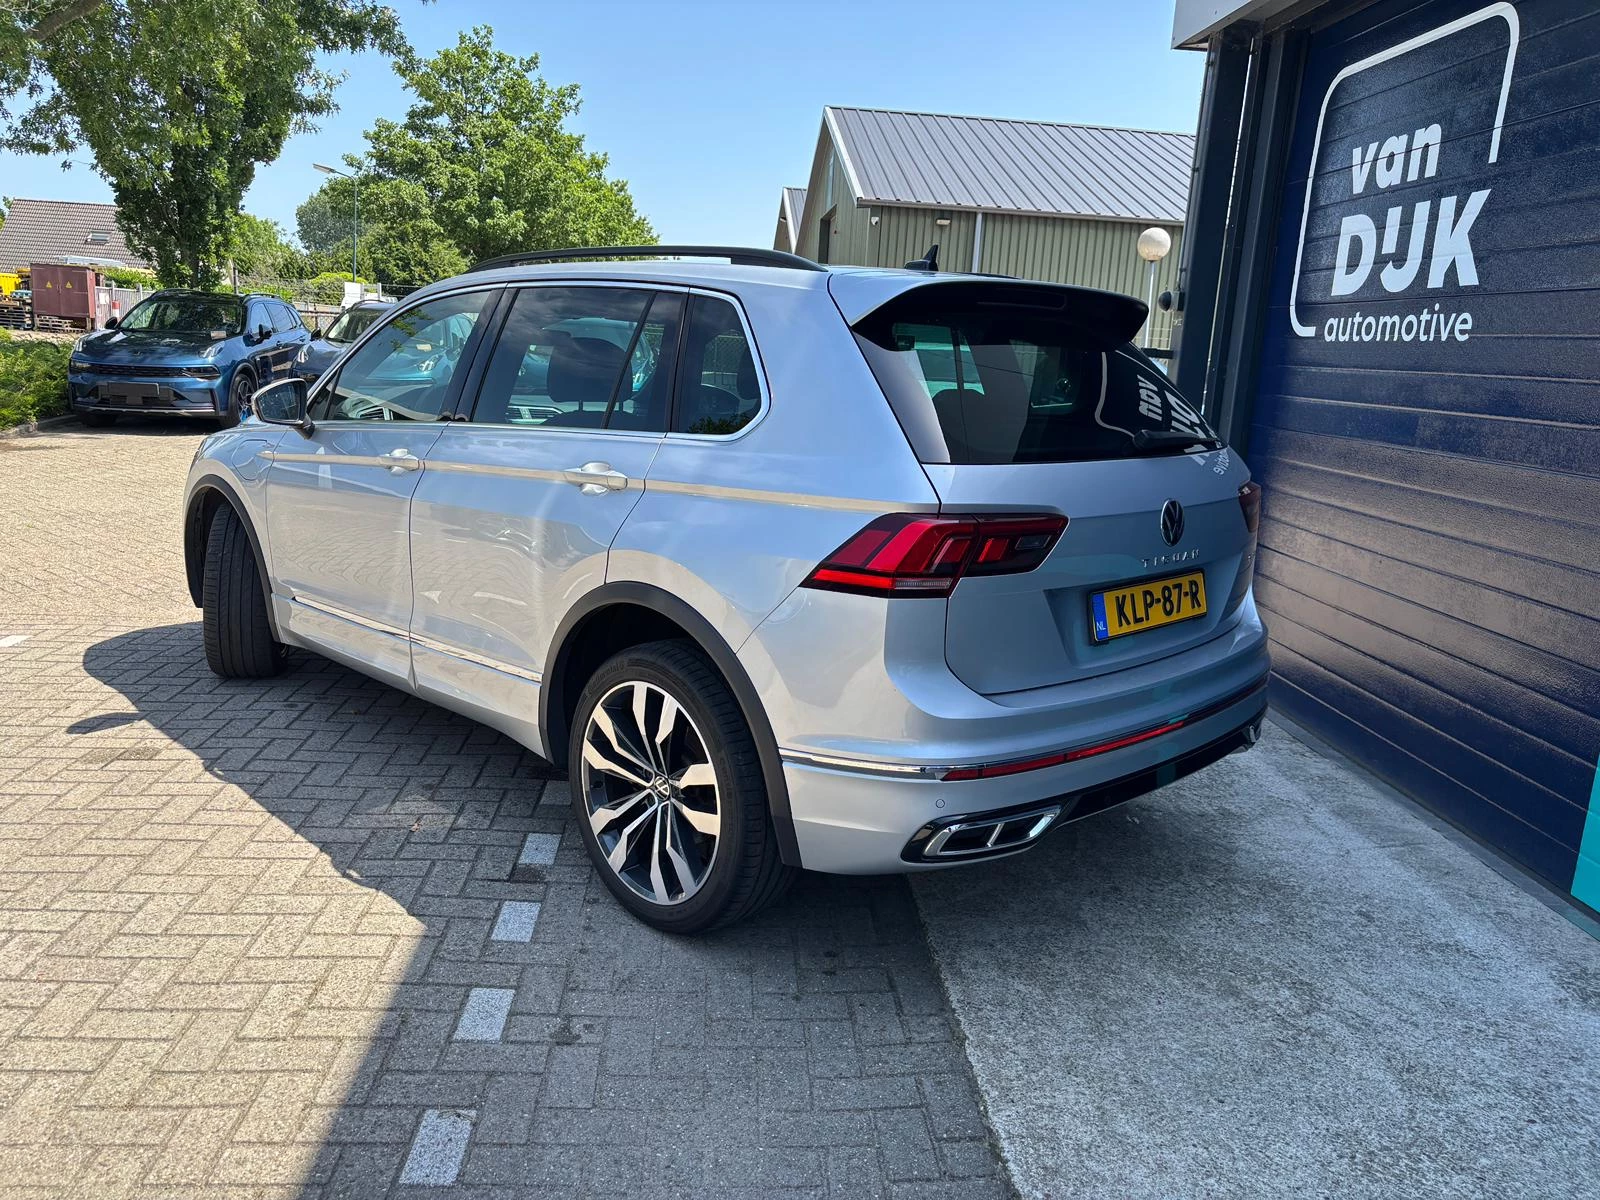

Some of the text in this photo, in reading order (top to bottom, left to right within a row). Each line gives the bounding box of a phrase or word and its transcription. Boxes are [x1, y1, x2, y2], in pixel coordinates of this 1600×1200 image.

[1352, 123, 1442, 194] van
[1331, 189, 1492, 296] DIJK
[1324, 303, 1473, 342] automotive
[1141, 549, 1200, 568] TIGUAN
[1115, 579, 1202, 628] KLP-87-R
[1096, 621, 1107, 632] NL
